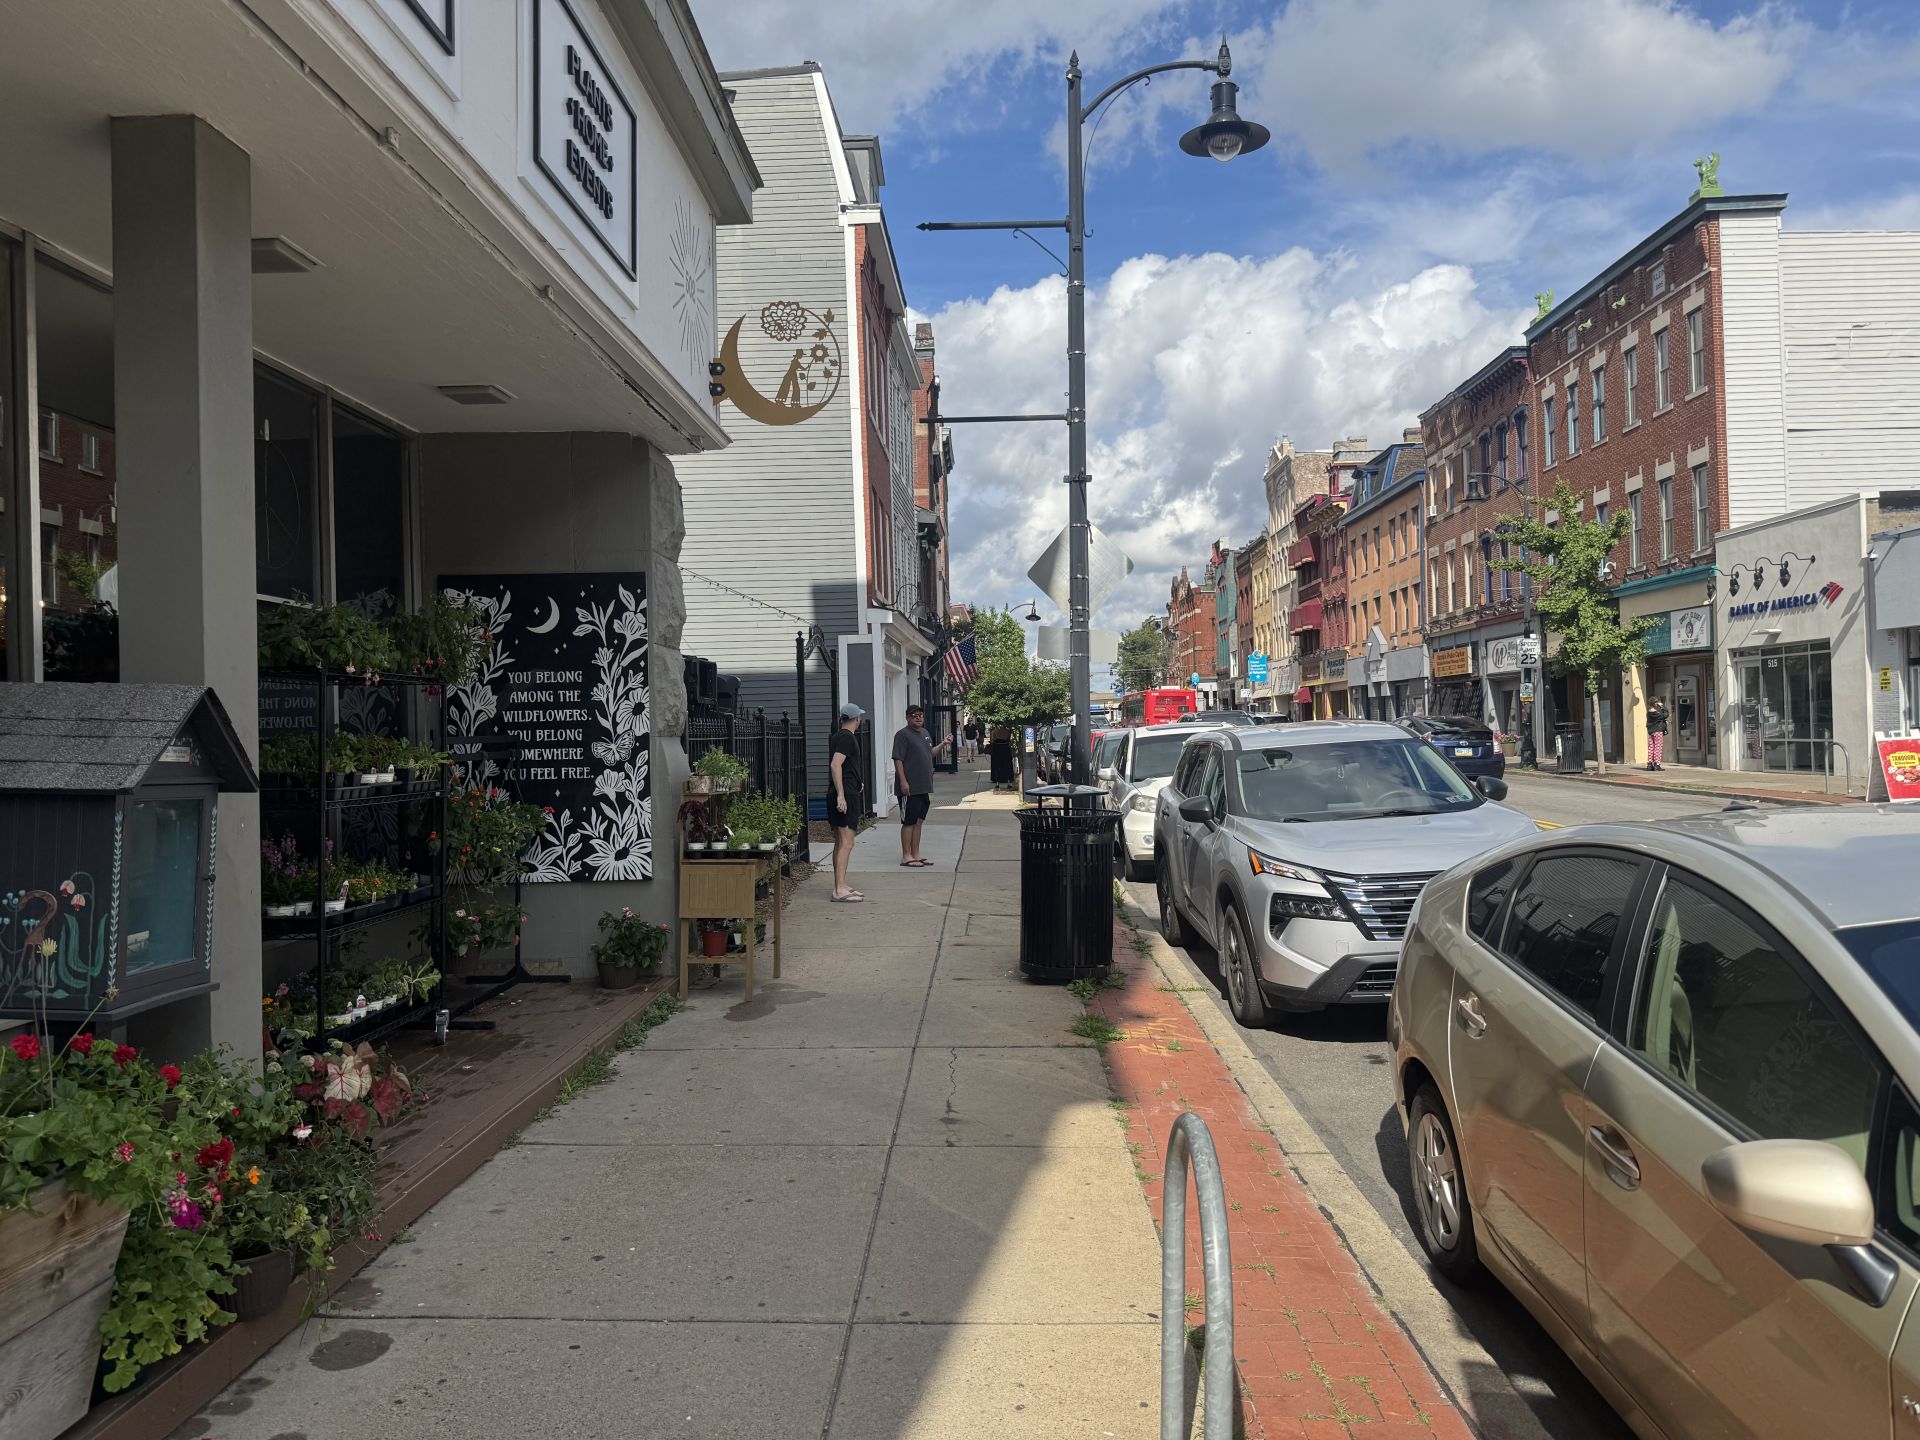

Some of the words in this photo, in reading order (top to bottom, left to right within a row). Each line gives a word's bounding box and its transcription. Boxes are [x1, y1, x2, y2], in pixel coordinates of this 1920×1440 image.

[567, 45, 614, 132] PLANTS
[566, 139, 614, 219] EVENTS
[1729, 604, 1755, 617] BANK
[1757, 600, 1769, 613] OF
[1771, 593, 1818, 611] AMERICA
[1520, 653, 1537, 665] 25
[1767, 658, 1778, 668] 515
[507, 671, 532, 684] YOU
[535, 670, 583, 683] BELONG
[509, 690, 554, 703] AMONG
[558, 690, 581, 702] THE
[502, 709, 592, 722] WILDFLOWERS.
[536, 728, 583, 742] BELONG
[530, 767, 557, 780] FEEL
[561, 766, 594, 779] FREE.
